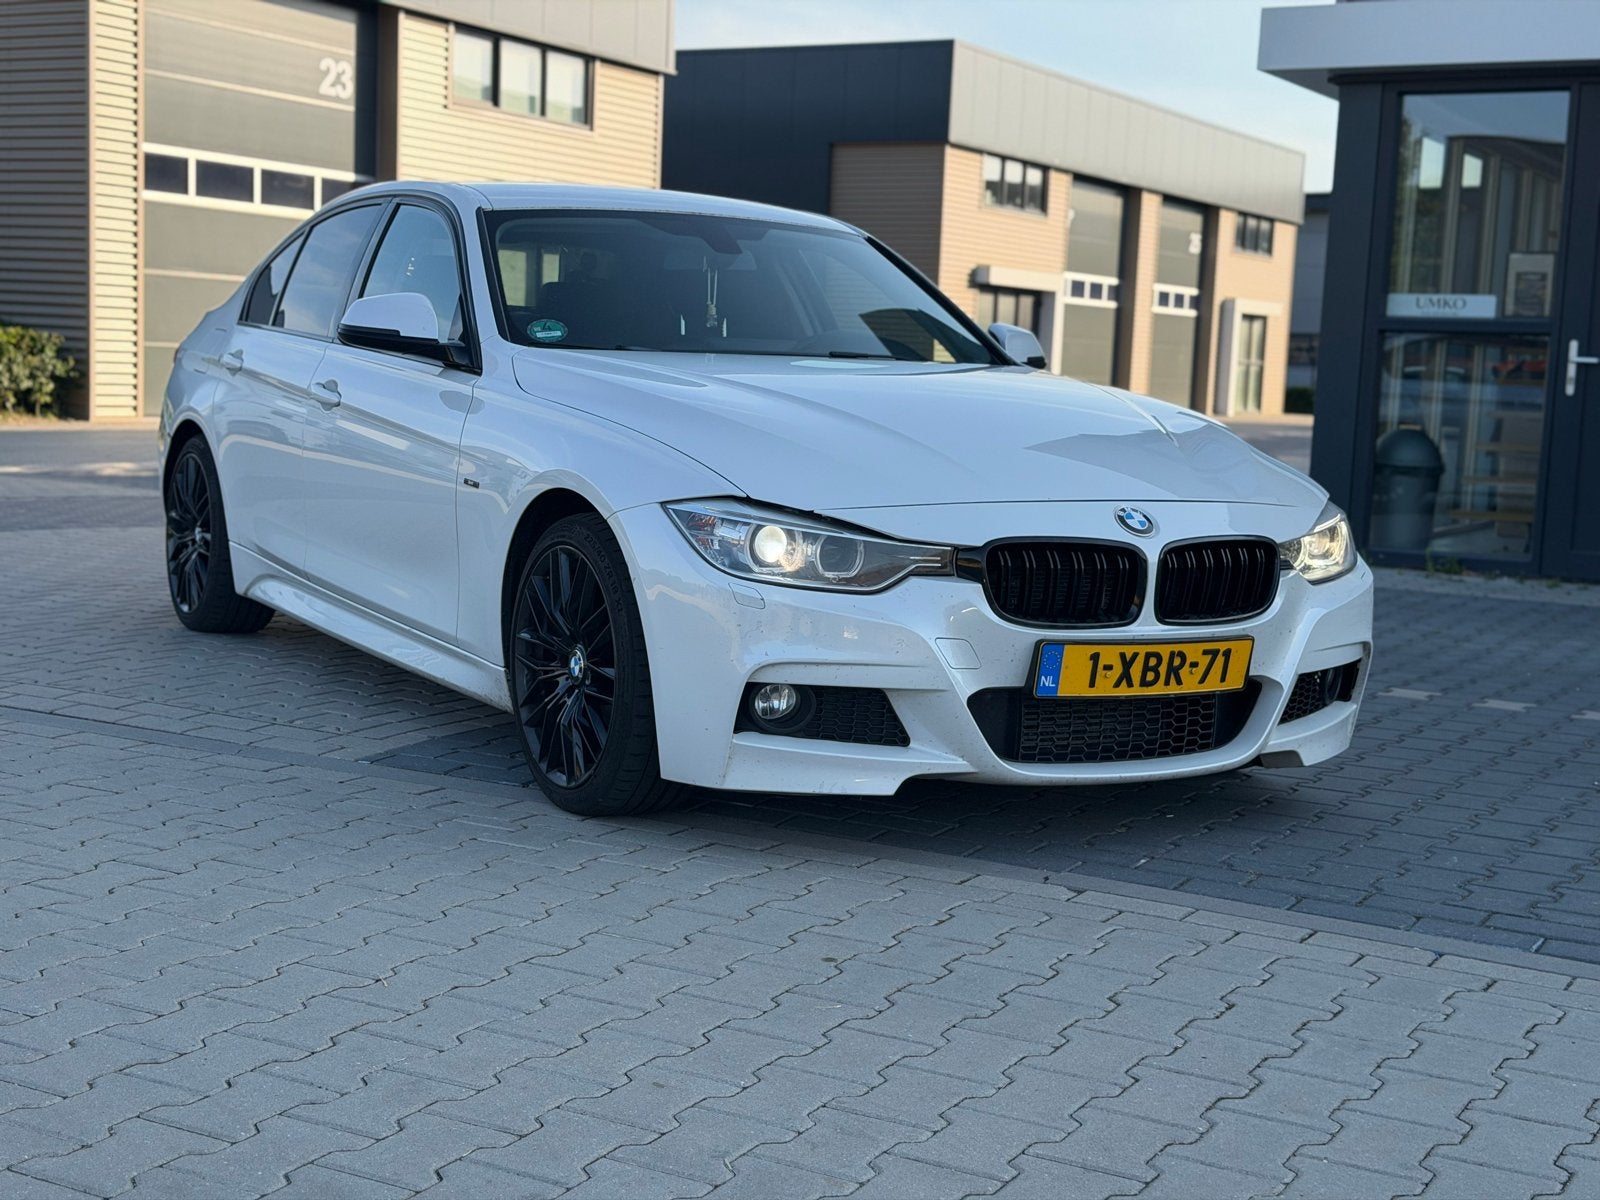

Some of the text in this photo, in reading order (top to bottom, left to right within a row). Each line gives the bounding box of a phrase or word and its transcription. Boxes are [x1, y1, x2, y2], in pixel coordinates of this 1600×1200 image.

[319, 57, 354, 99] 23
[1415, 296, 1468, 310] UMKO
[1040, 675, 1056, 687] NL
[1088, 648, 1232, 688] 1-XBR-71
